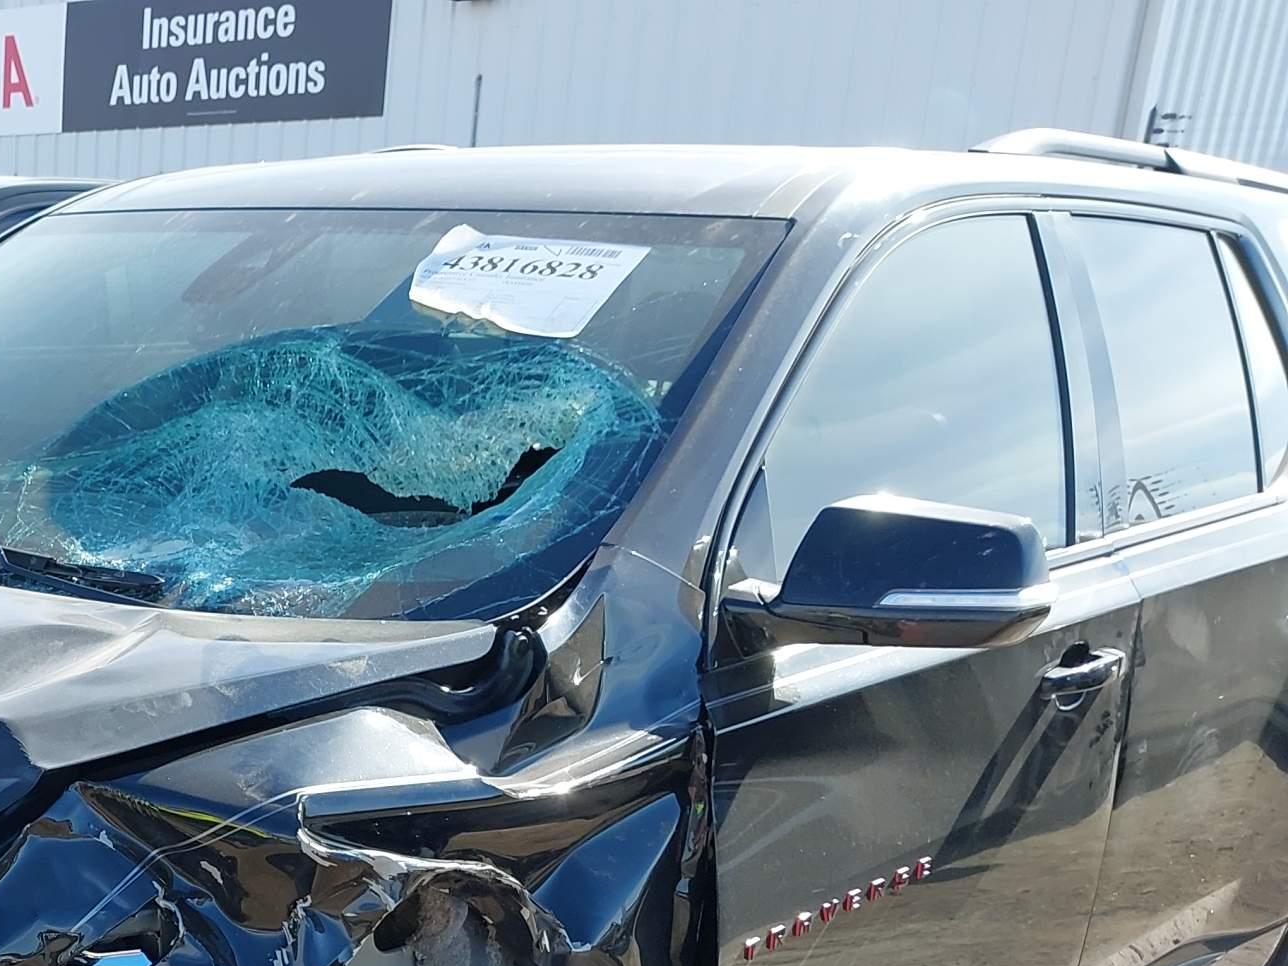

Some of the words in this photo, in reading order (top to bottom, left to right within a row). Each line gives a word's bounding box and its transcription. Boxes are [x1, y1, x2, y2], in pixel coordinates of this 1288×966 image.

[142, 4, 296, 50] Insurance
[109, 64, 178, 106] Auto
[184, 52, 326, 101] Auctions
[443, 254, 605, 281] 43816828
[743, 856, 933, 961] TRAVERSE
